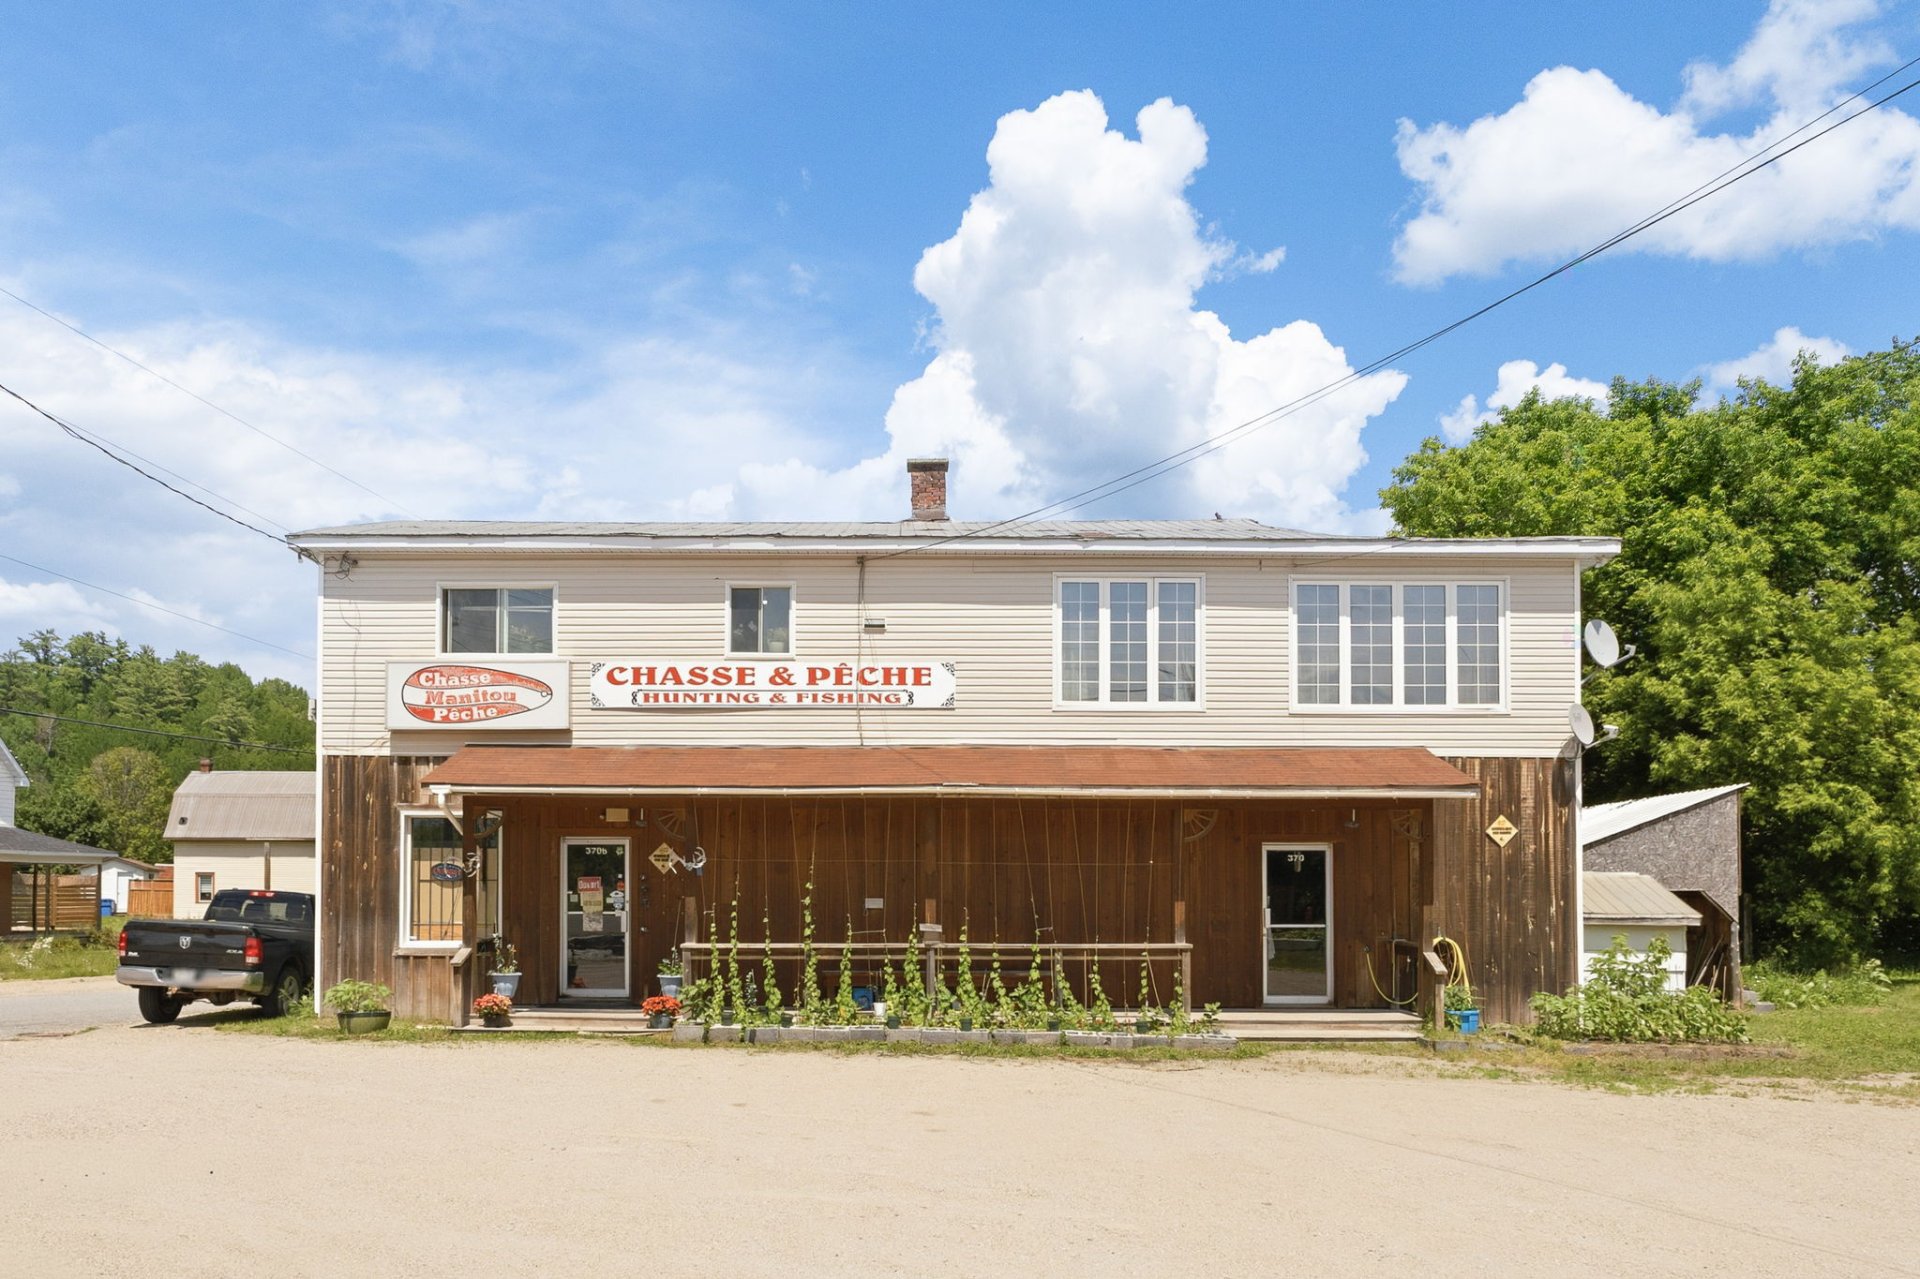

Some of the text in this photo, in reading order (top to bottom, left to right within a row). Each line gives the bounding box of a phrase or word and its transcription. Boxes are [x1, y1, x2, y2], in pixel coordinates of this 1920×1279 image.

[418, 671, 491, 687] Chasse
[606, 662, 932, 686] CHASSE & PÊCHE
[424, 689, 518, 706] Manitou
[642, 692, 902, 704] HUNTING & FISHING
[432, 706, 498, 722] Pêche
